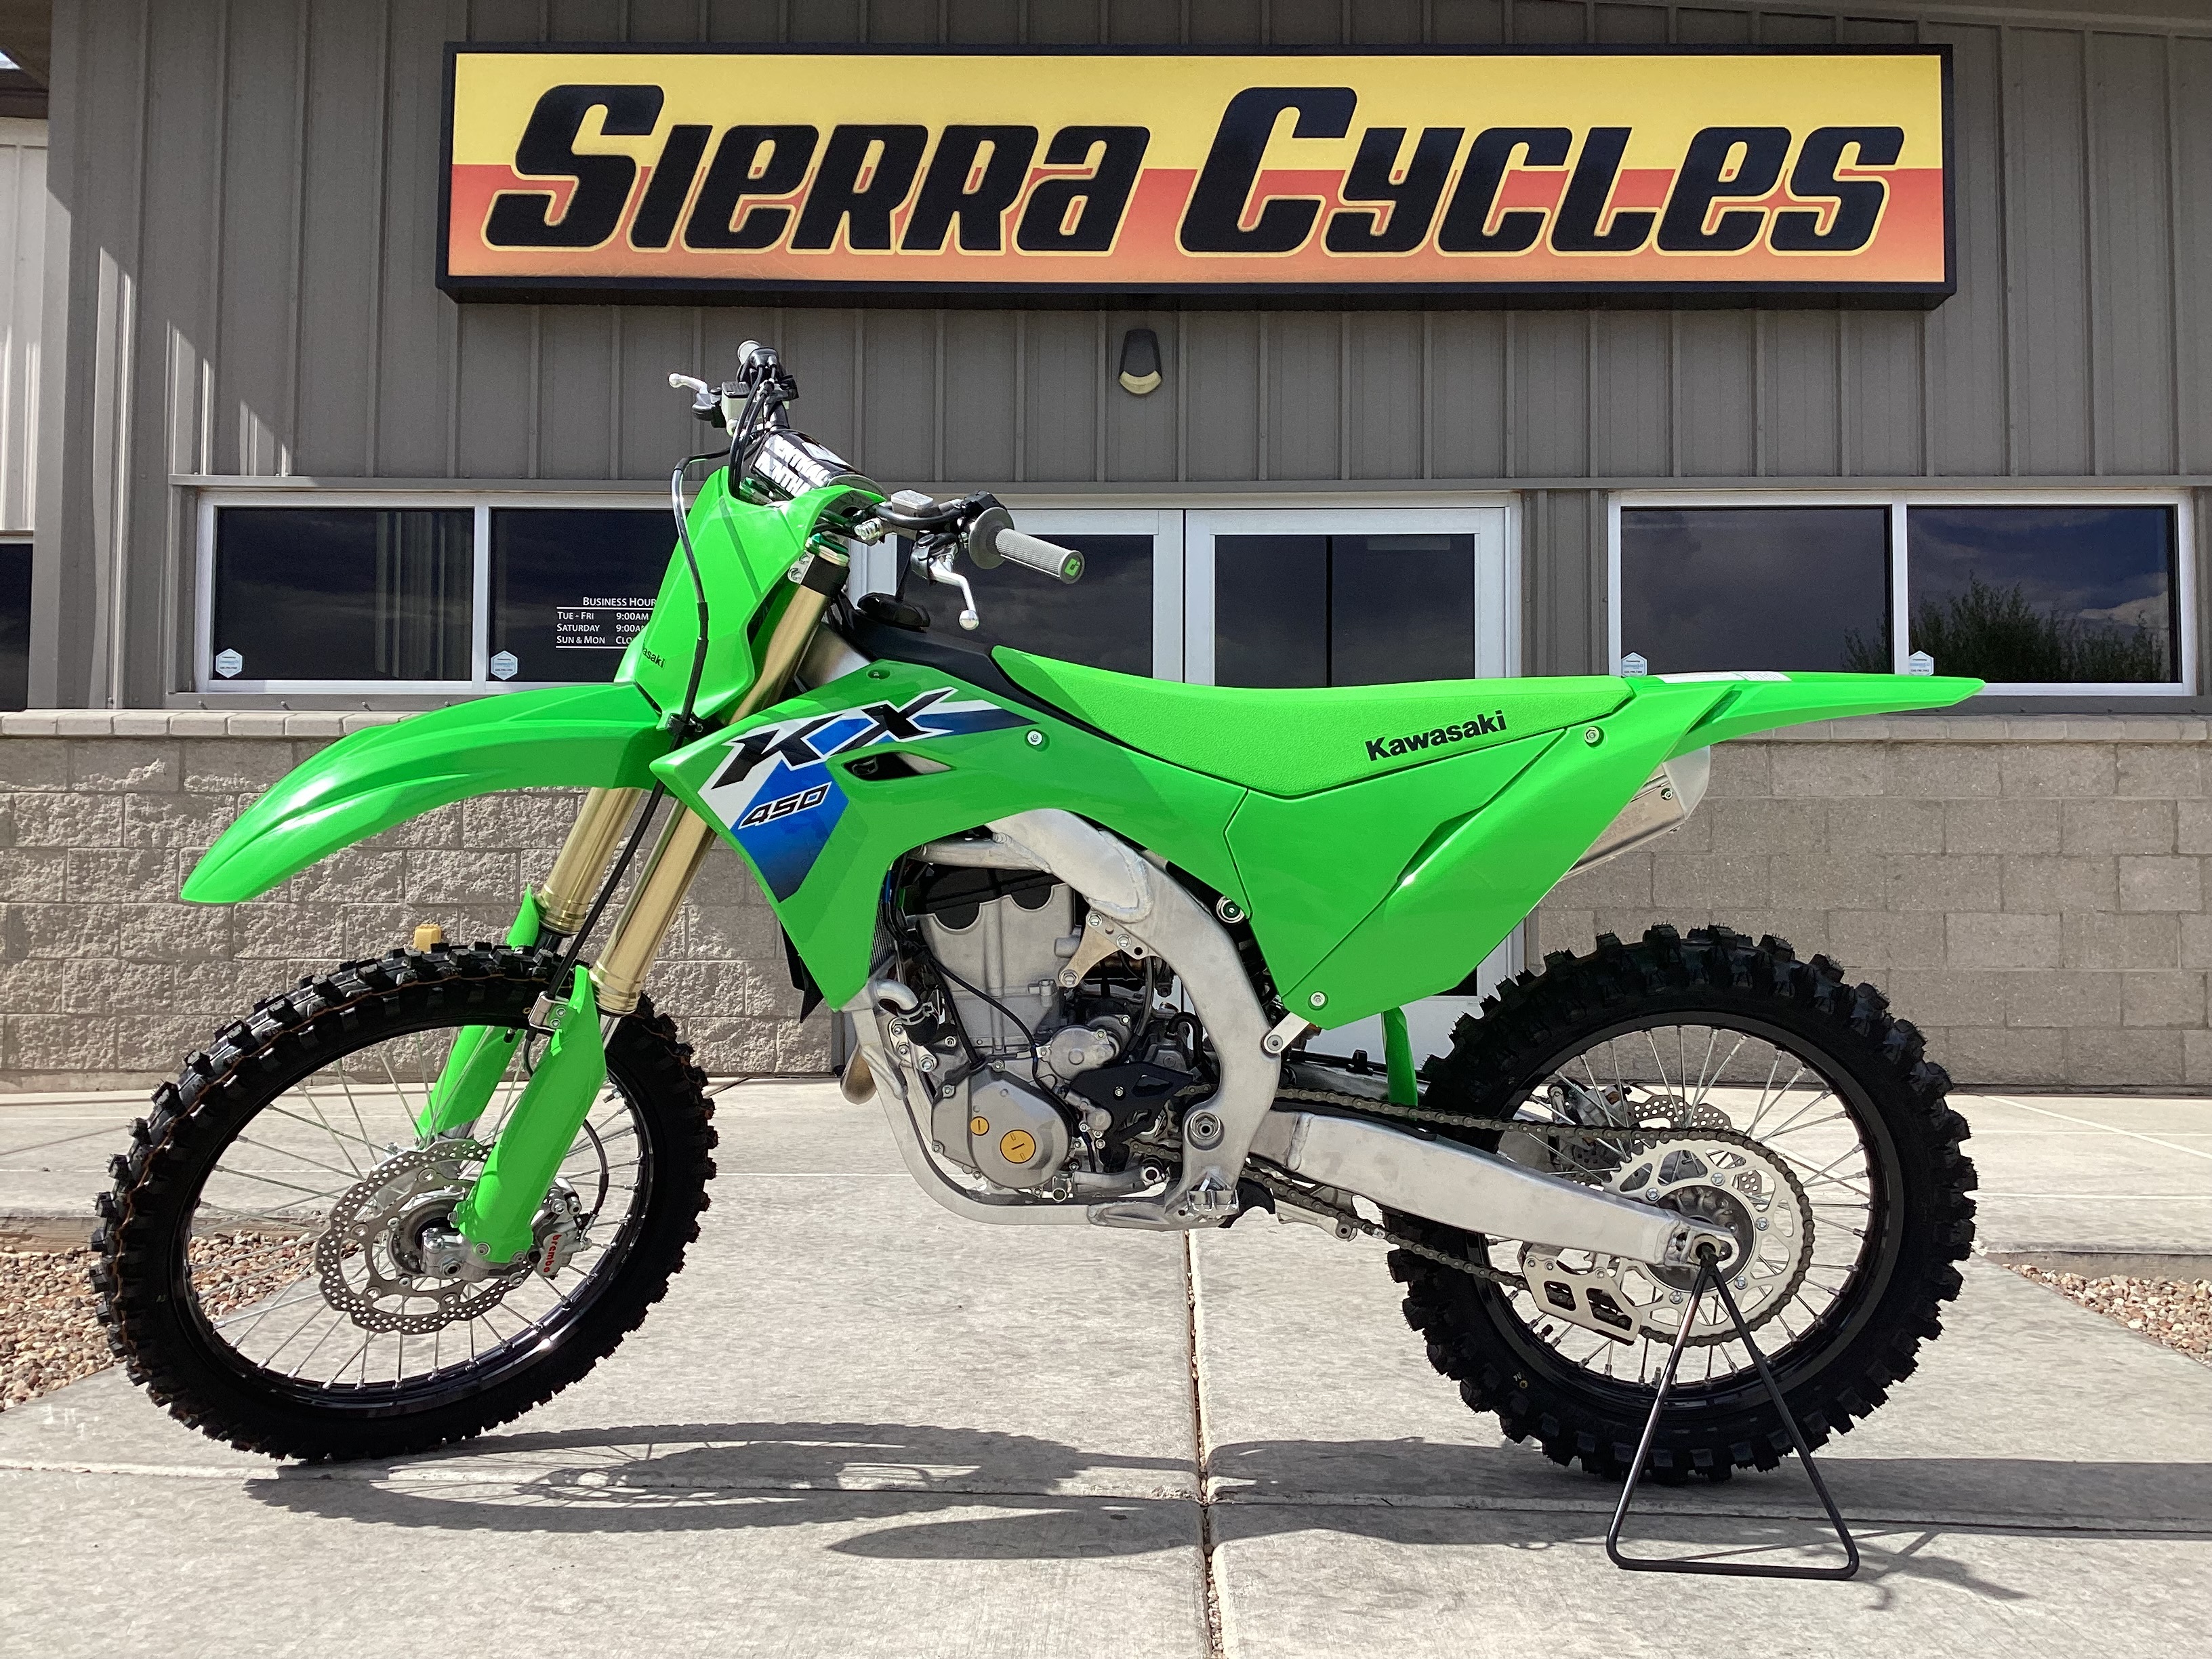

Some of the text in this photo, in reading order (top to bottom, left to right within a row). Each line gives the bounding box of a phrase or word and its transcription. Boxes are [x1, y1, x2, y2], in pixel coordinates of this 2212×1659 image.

[754, 451, 815, 497] RENTHA
[557, 611, 574, 619] TUE
[581, 612, 594, 620] FRI
[616, 612, 649, 620] 9:00AM
[583, 597, 657, 607] BUSINESS HOUR
[556, 623, 600, 632] SATURDAY
[556, 635, 633, 644] SUN & MON CLO
[711, 688, 954, 790] KX
[1365, 710, 1507, 761] Kawasaki
[739, 783, 832, 829] 450
[544, 1234, 562, 1273] brembo
